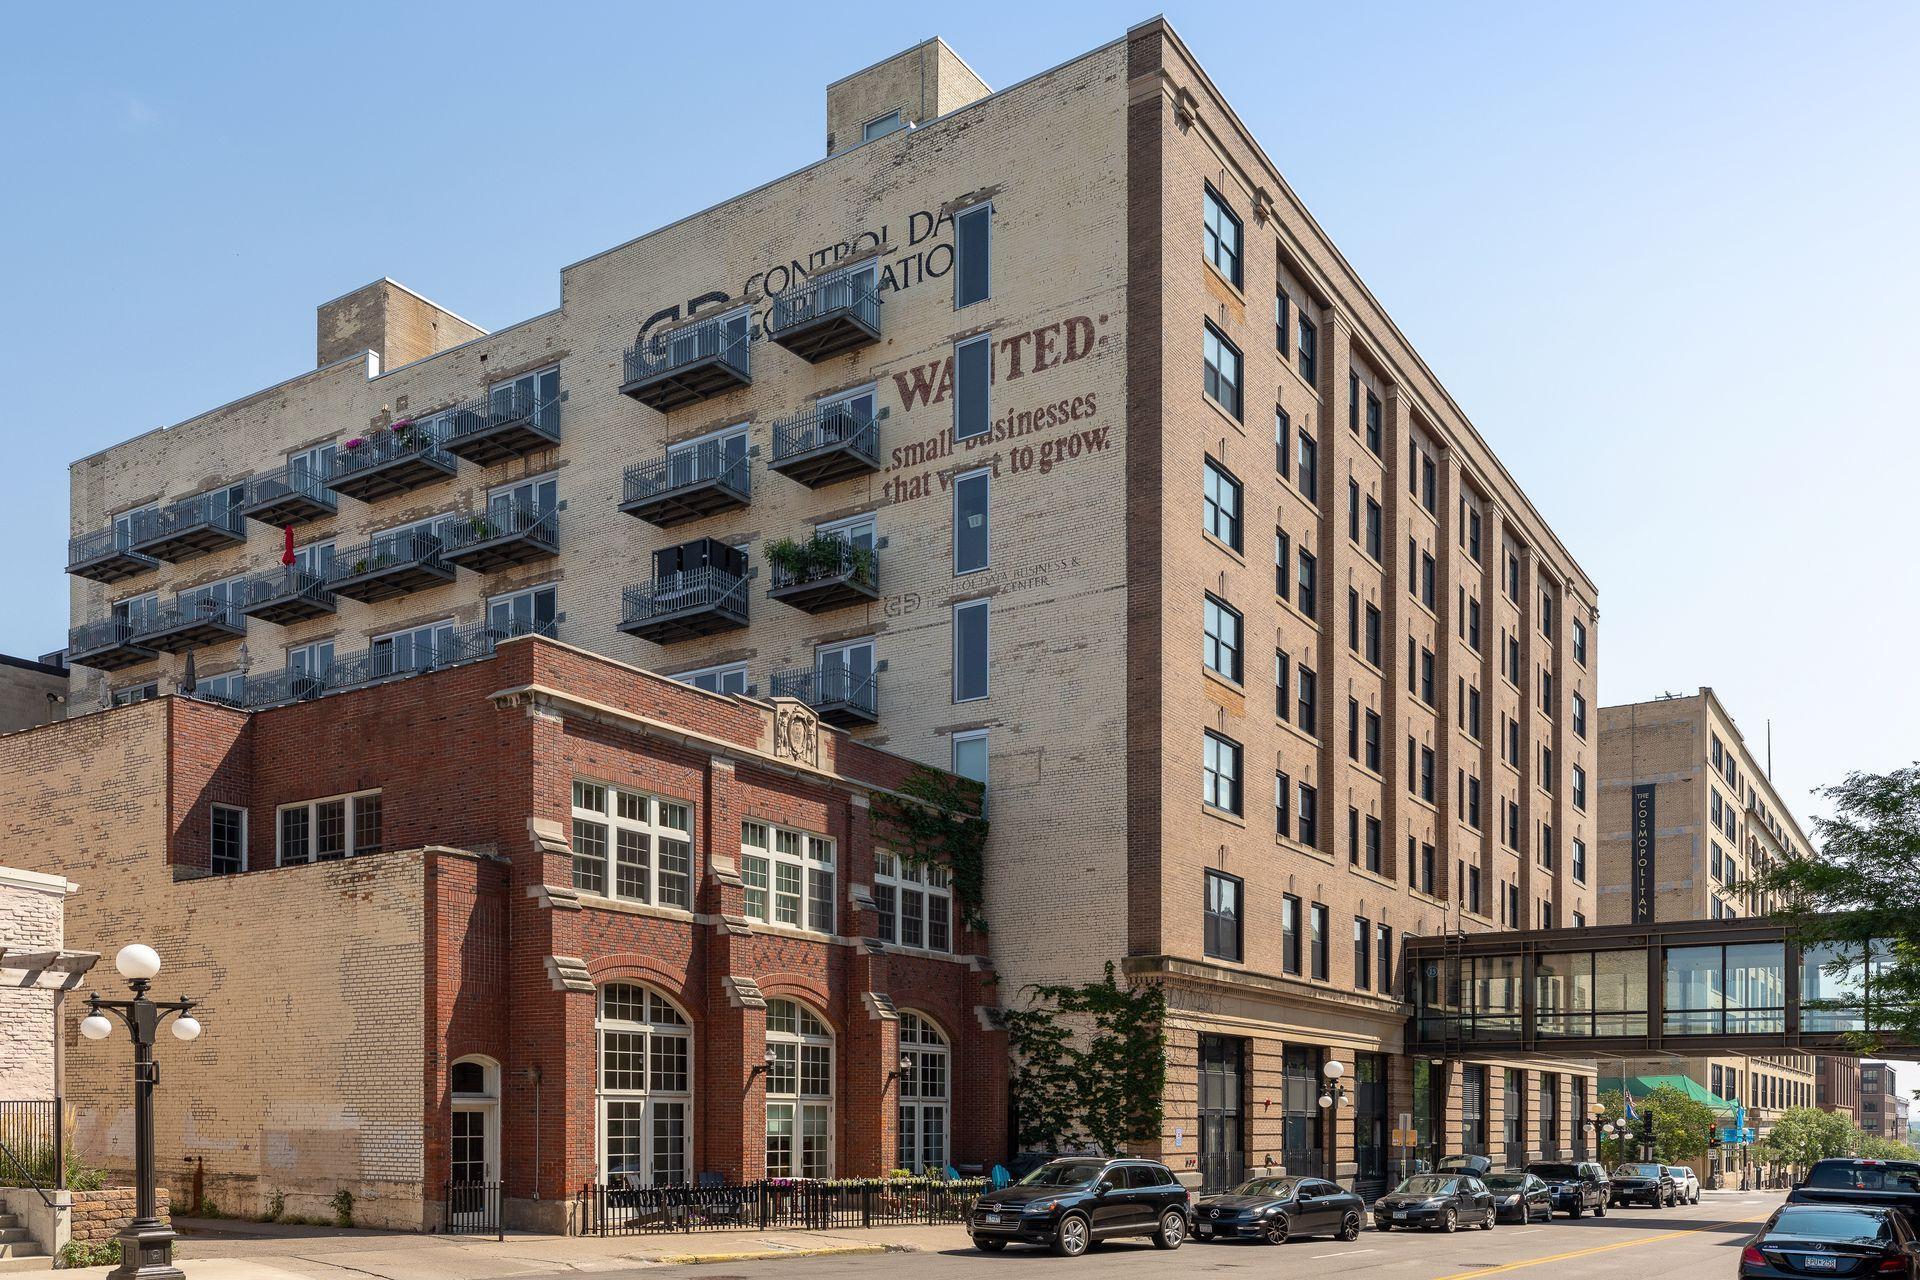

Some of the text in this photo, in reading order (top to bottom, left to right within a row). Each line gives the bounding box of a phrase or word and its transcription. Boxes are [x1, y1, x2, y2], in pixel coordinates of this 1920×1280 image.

[1010, 445, 1033, 475] to
[1040, 426, 1110, 475] grow.
[1638, 800, 1648, 915] COSMOPOLITAN
